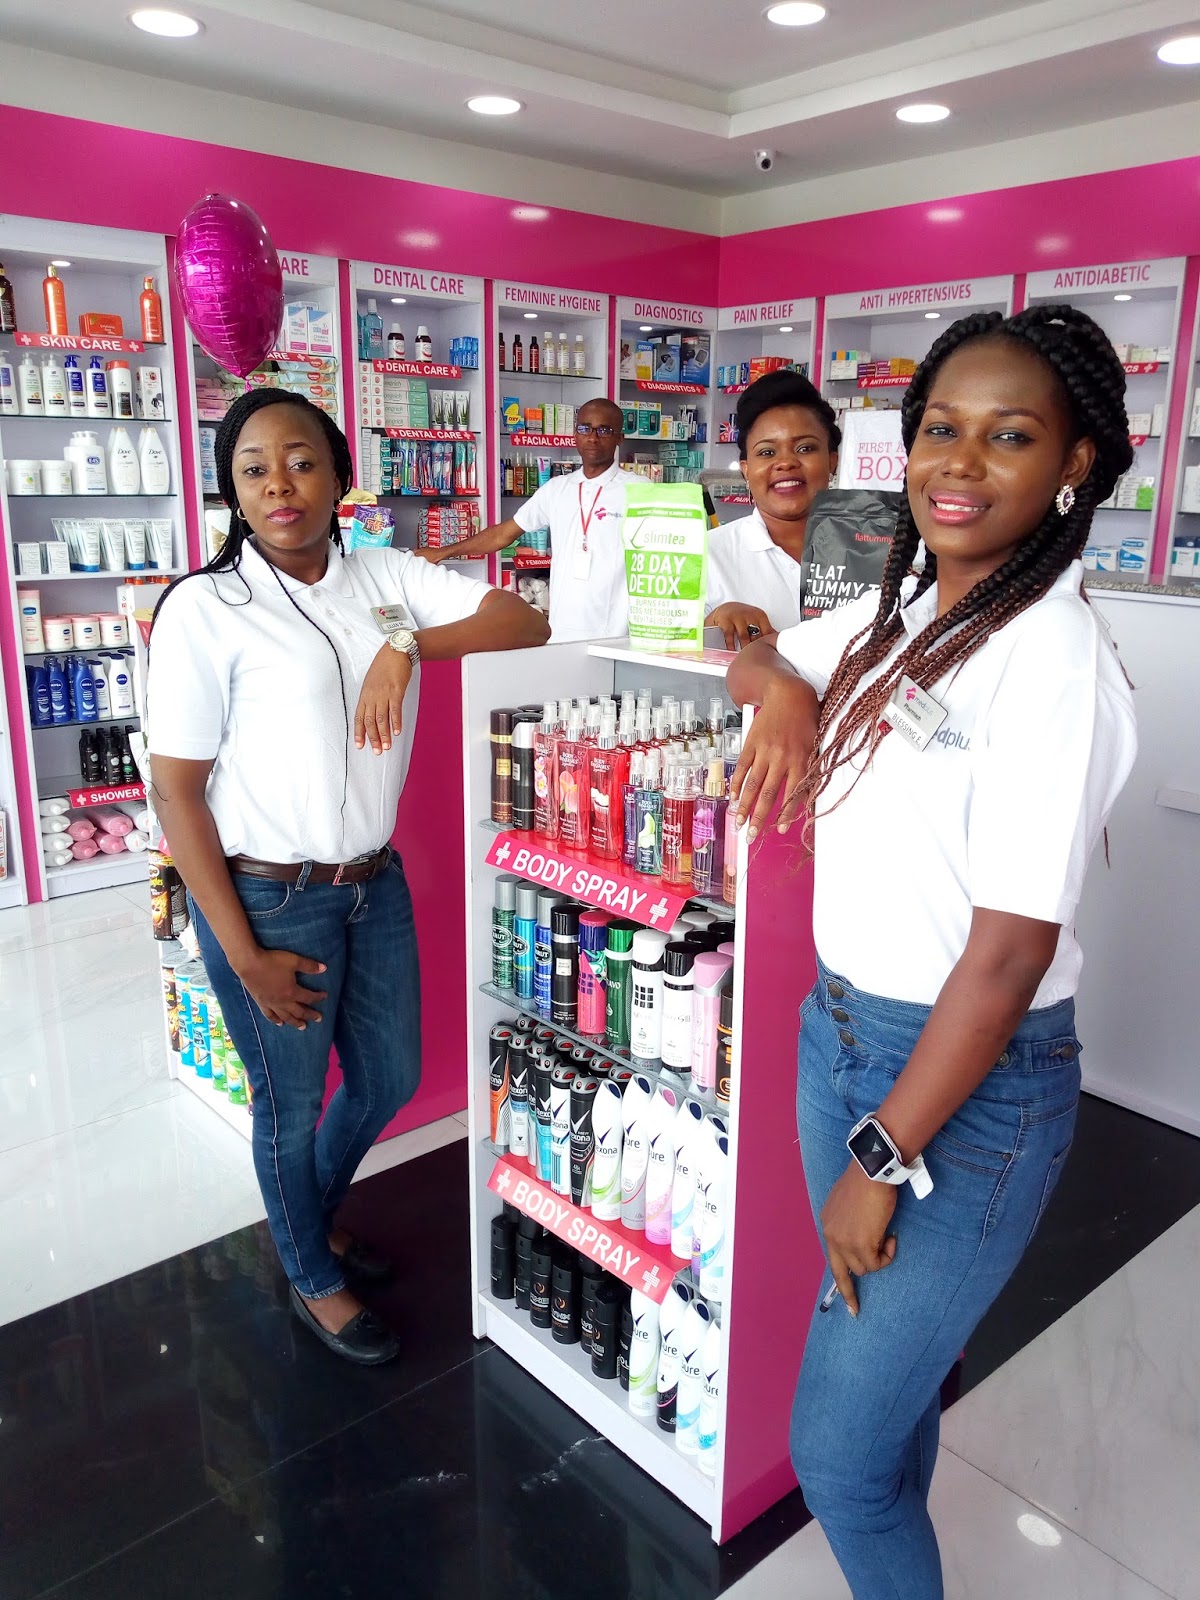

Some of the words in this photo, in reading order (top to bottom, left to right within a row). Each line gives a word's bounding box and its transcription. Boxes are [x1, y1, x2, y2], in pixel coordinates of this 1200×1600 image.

[280, 257, 309, 277] ARE
[373, 267, 427, 291] DENTAL
[430, 275, 465, 295] CARE
[1054, 264, 1151, 289] ANTIDIABETIC
[505, 287, 556, 307] FEMININE
[558, 296, 601, 313] HYGIENE
[860, 296, 883, 311] ANTI
[888, 283, 971, 307] HYPERTENSIVES
[634, 302, 704, 325] DIAGNOSTICS
[734, 308, 757, 324] PAIN
[760, 303, 794, 321] RELIEF
[39, 335, 80, 349] SKIN
[81, 336, 123, 351] CARE
[385, 362, 423, 374] DENTAL
[423, 365, 450, 376] CARE
[646, 382, 696, 393] DIAGNOSTICS
[869, 378, 884, 386] ANTI
[398, 429, 437, 439] DENTAL
[437, 430, 464, 440] CARE
[521, 435, 553, 446] FACIAL
[553, 437, 577, 447] CARE
[858, 442, 893, 454] FIRST
[643, 529, 686, 545] slimtea
[631, 552, 645, 573] 28
[648, 554, 687, 575] DAY
[629, 573, 681, 596] DETOX
[635, 598, 657, 607] BURNS
[657, 600, 671, 608] FAT
[803, 594, 834, 609] WITH
[633, 614, 673, 626] REVITALISES
[644, 607, 689, 618] METABOLISM
[891, 712, 917, 741] BLESSING
[90, 788, 140, 803] SHOWER
[512, 848, 574, 887] BODY
[571, 869, 648, 914] SPRAY
[509, 1085, 529, 1096] Rexon
[571, 1133, 591, 1143] exona
[512, 1182, 570, 1229] BODY
[567, 1217, 641, 1276] SPRAY
